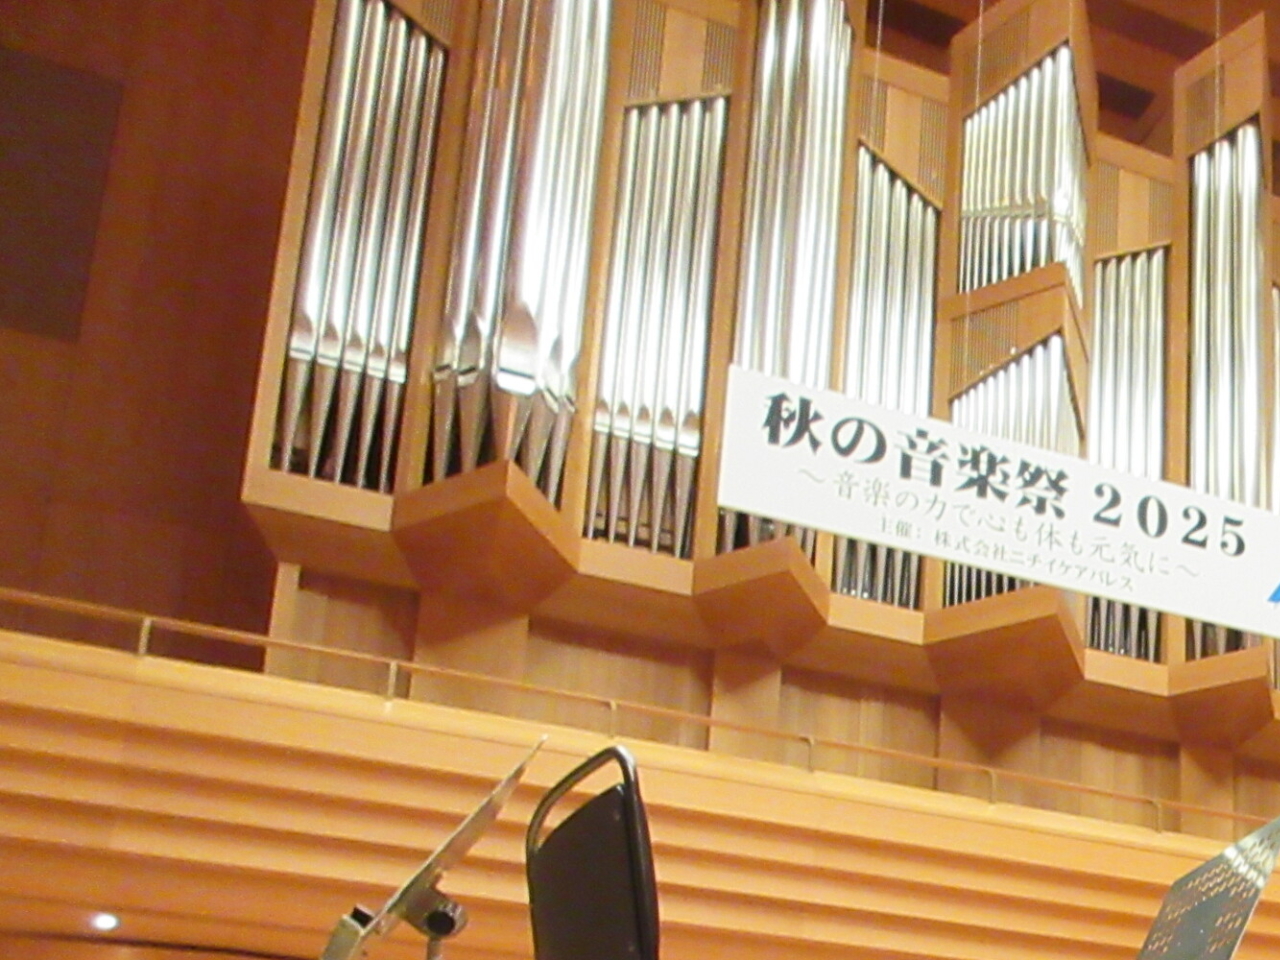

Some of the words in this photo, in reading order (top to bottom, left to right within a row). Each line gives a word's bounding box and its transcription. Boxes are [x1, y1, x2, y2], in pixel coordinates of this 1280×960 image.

[763, 392, 1069, 519] 秋の音楽祭
[1093, 482, 1246, 557] 2025
